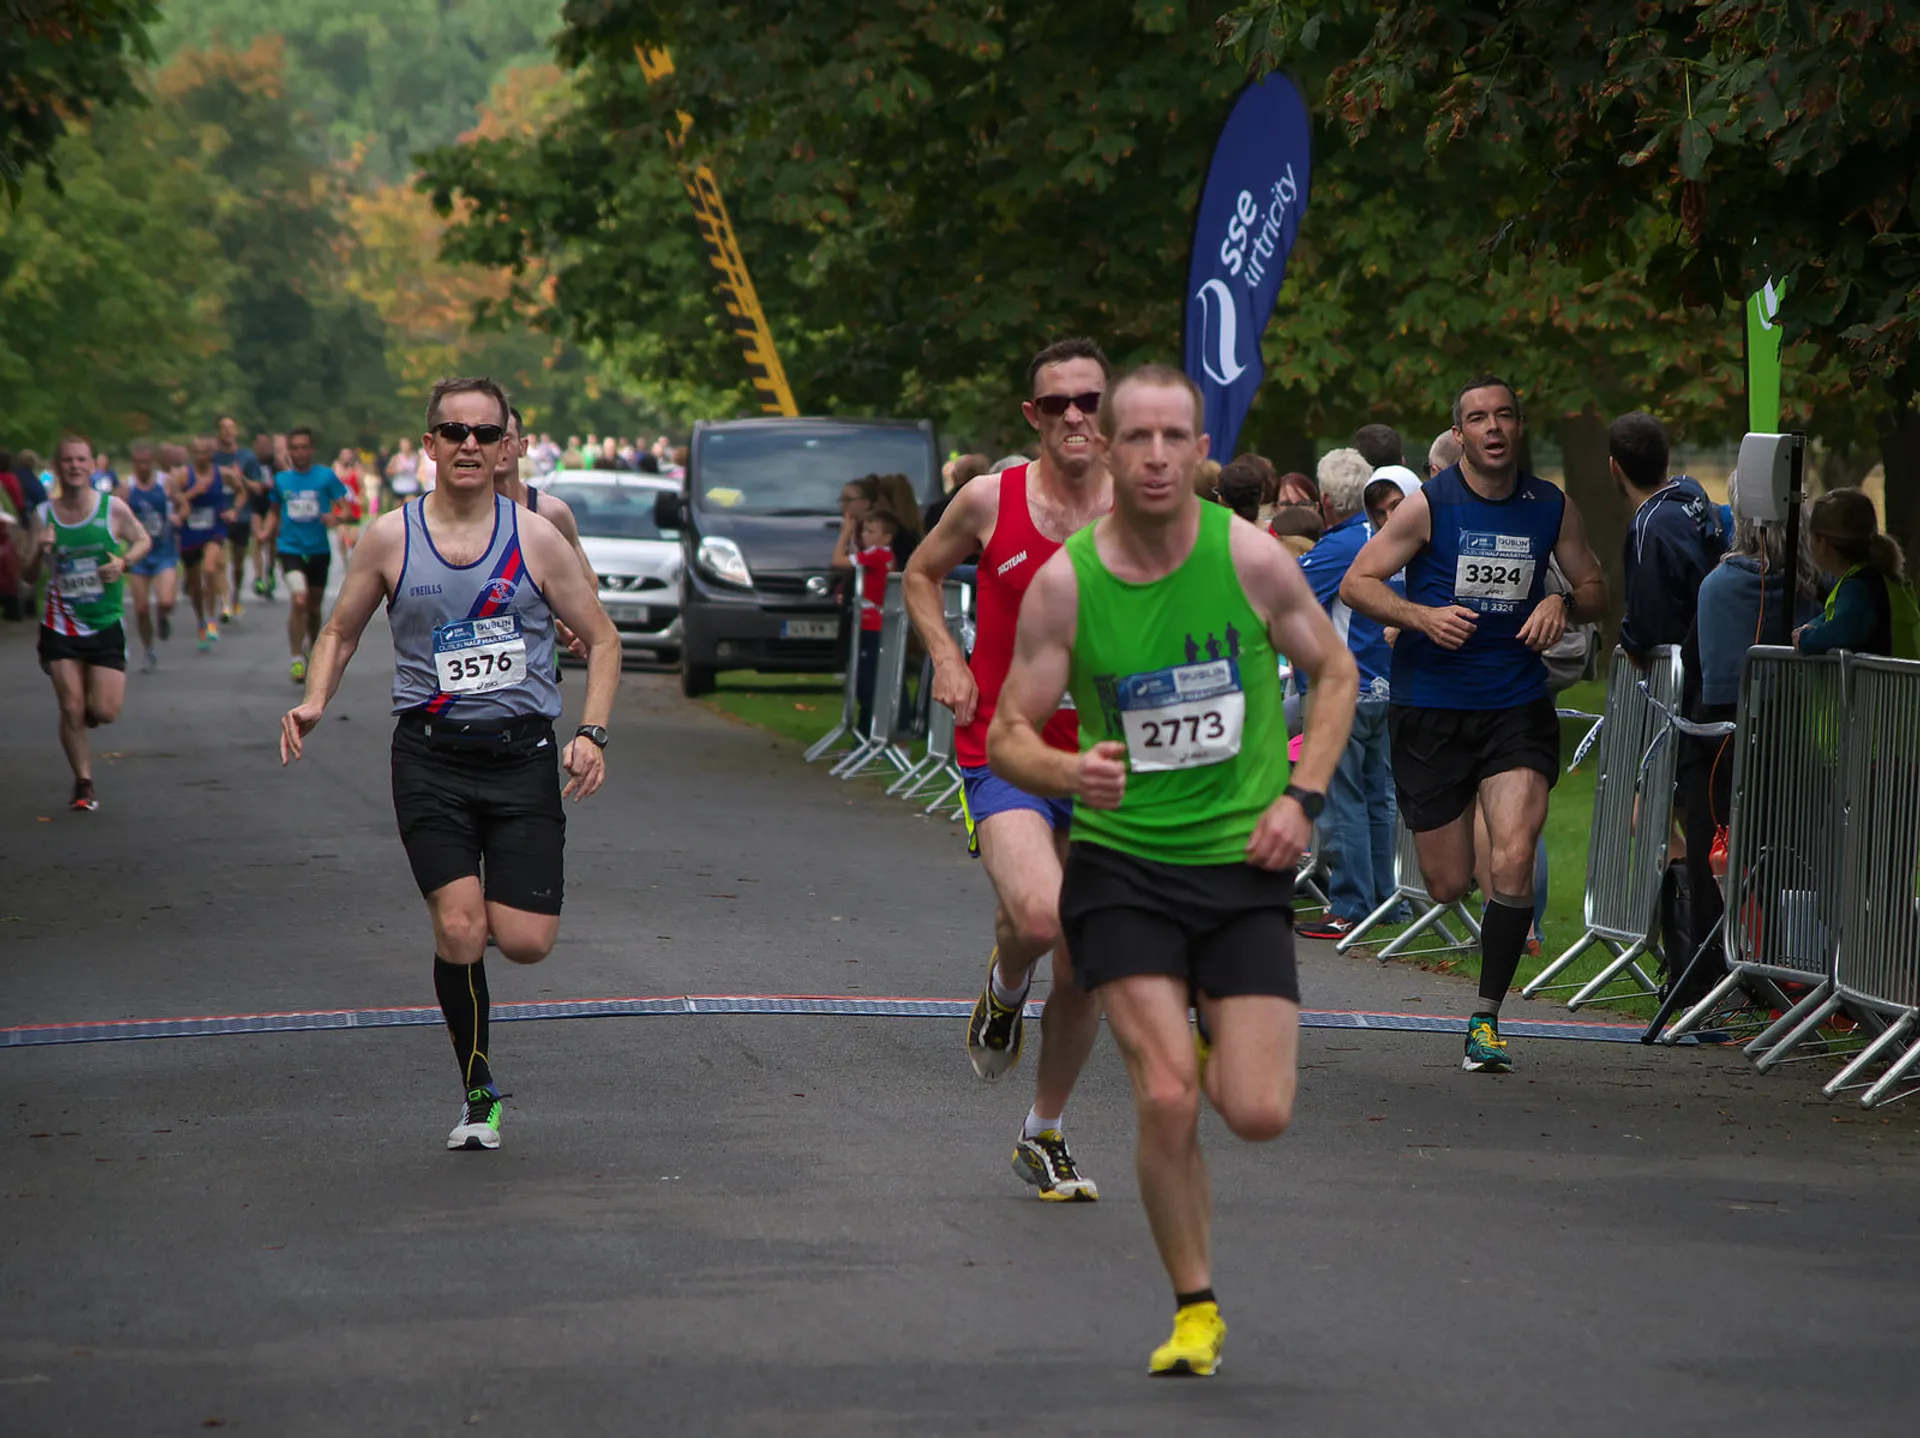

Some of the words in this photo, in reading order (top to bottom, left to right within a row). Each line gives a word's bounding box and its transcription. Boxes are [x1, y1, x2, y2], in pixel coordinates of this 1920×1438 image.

[1221, 189, 1257, 277] sse
[997, 550, 1028, 577] PROTEAM
[1465, 564, 1521, 586] 3324
[1490, 603, 1514, 612] 3324
[447, 651, 513, 681] 3576
[1141, 711, 1225, 748] 2773
